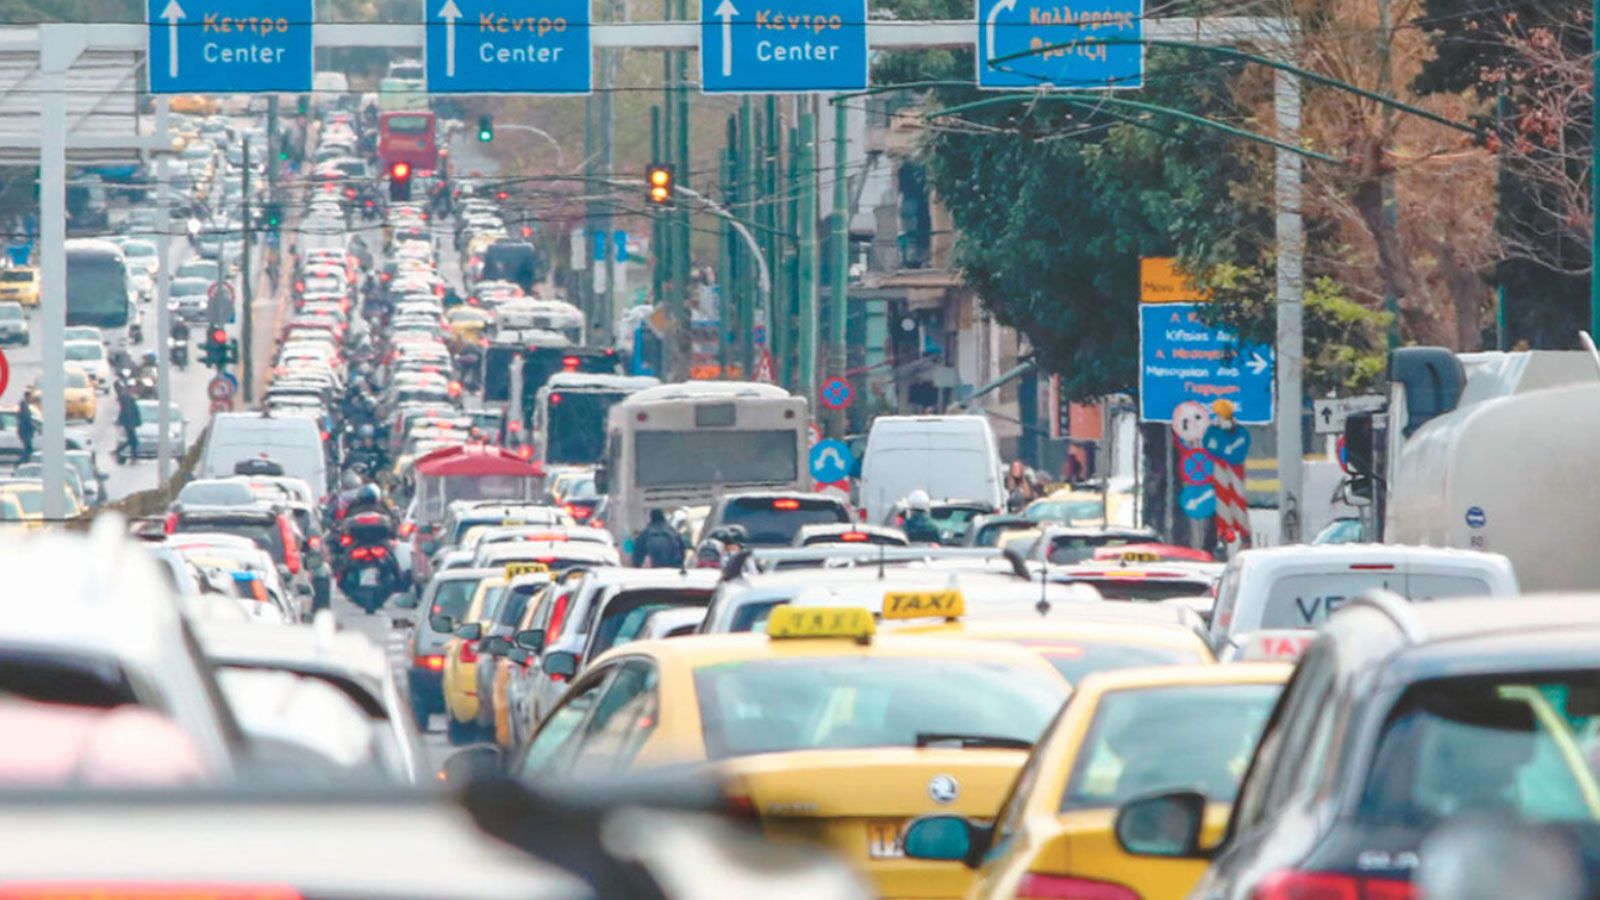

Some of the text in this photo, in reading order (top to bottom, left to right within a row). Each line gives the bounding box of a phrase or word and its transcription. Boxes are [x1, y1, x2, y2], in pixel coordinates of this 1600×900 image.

[203, 42, 285, 63] Center
[480, 42, 564, 63] Center
[756, 40, 840, 61] Center
[891, 594, 957, 613] TAXI
[791, 611, 861, 629] TAXI
